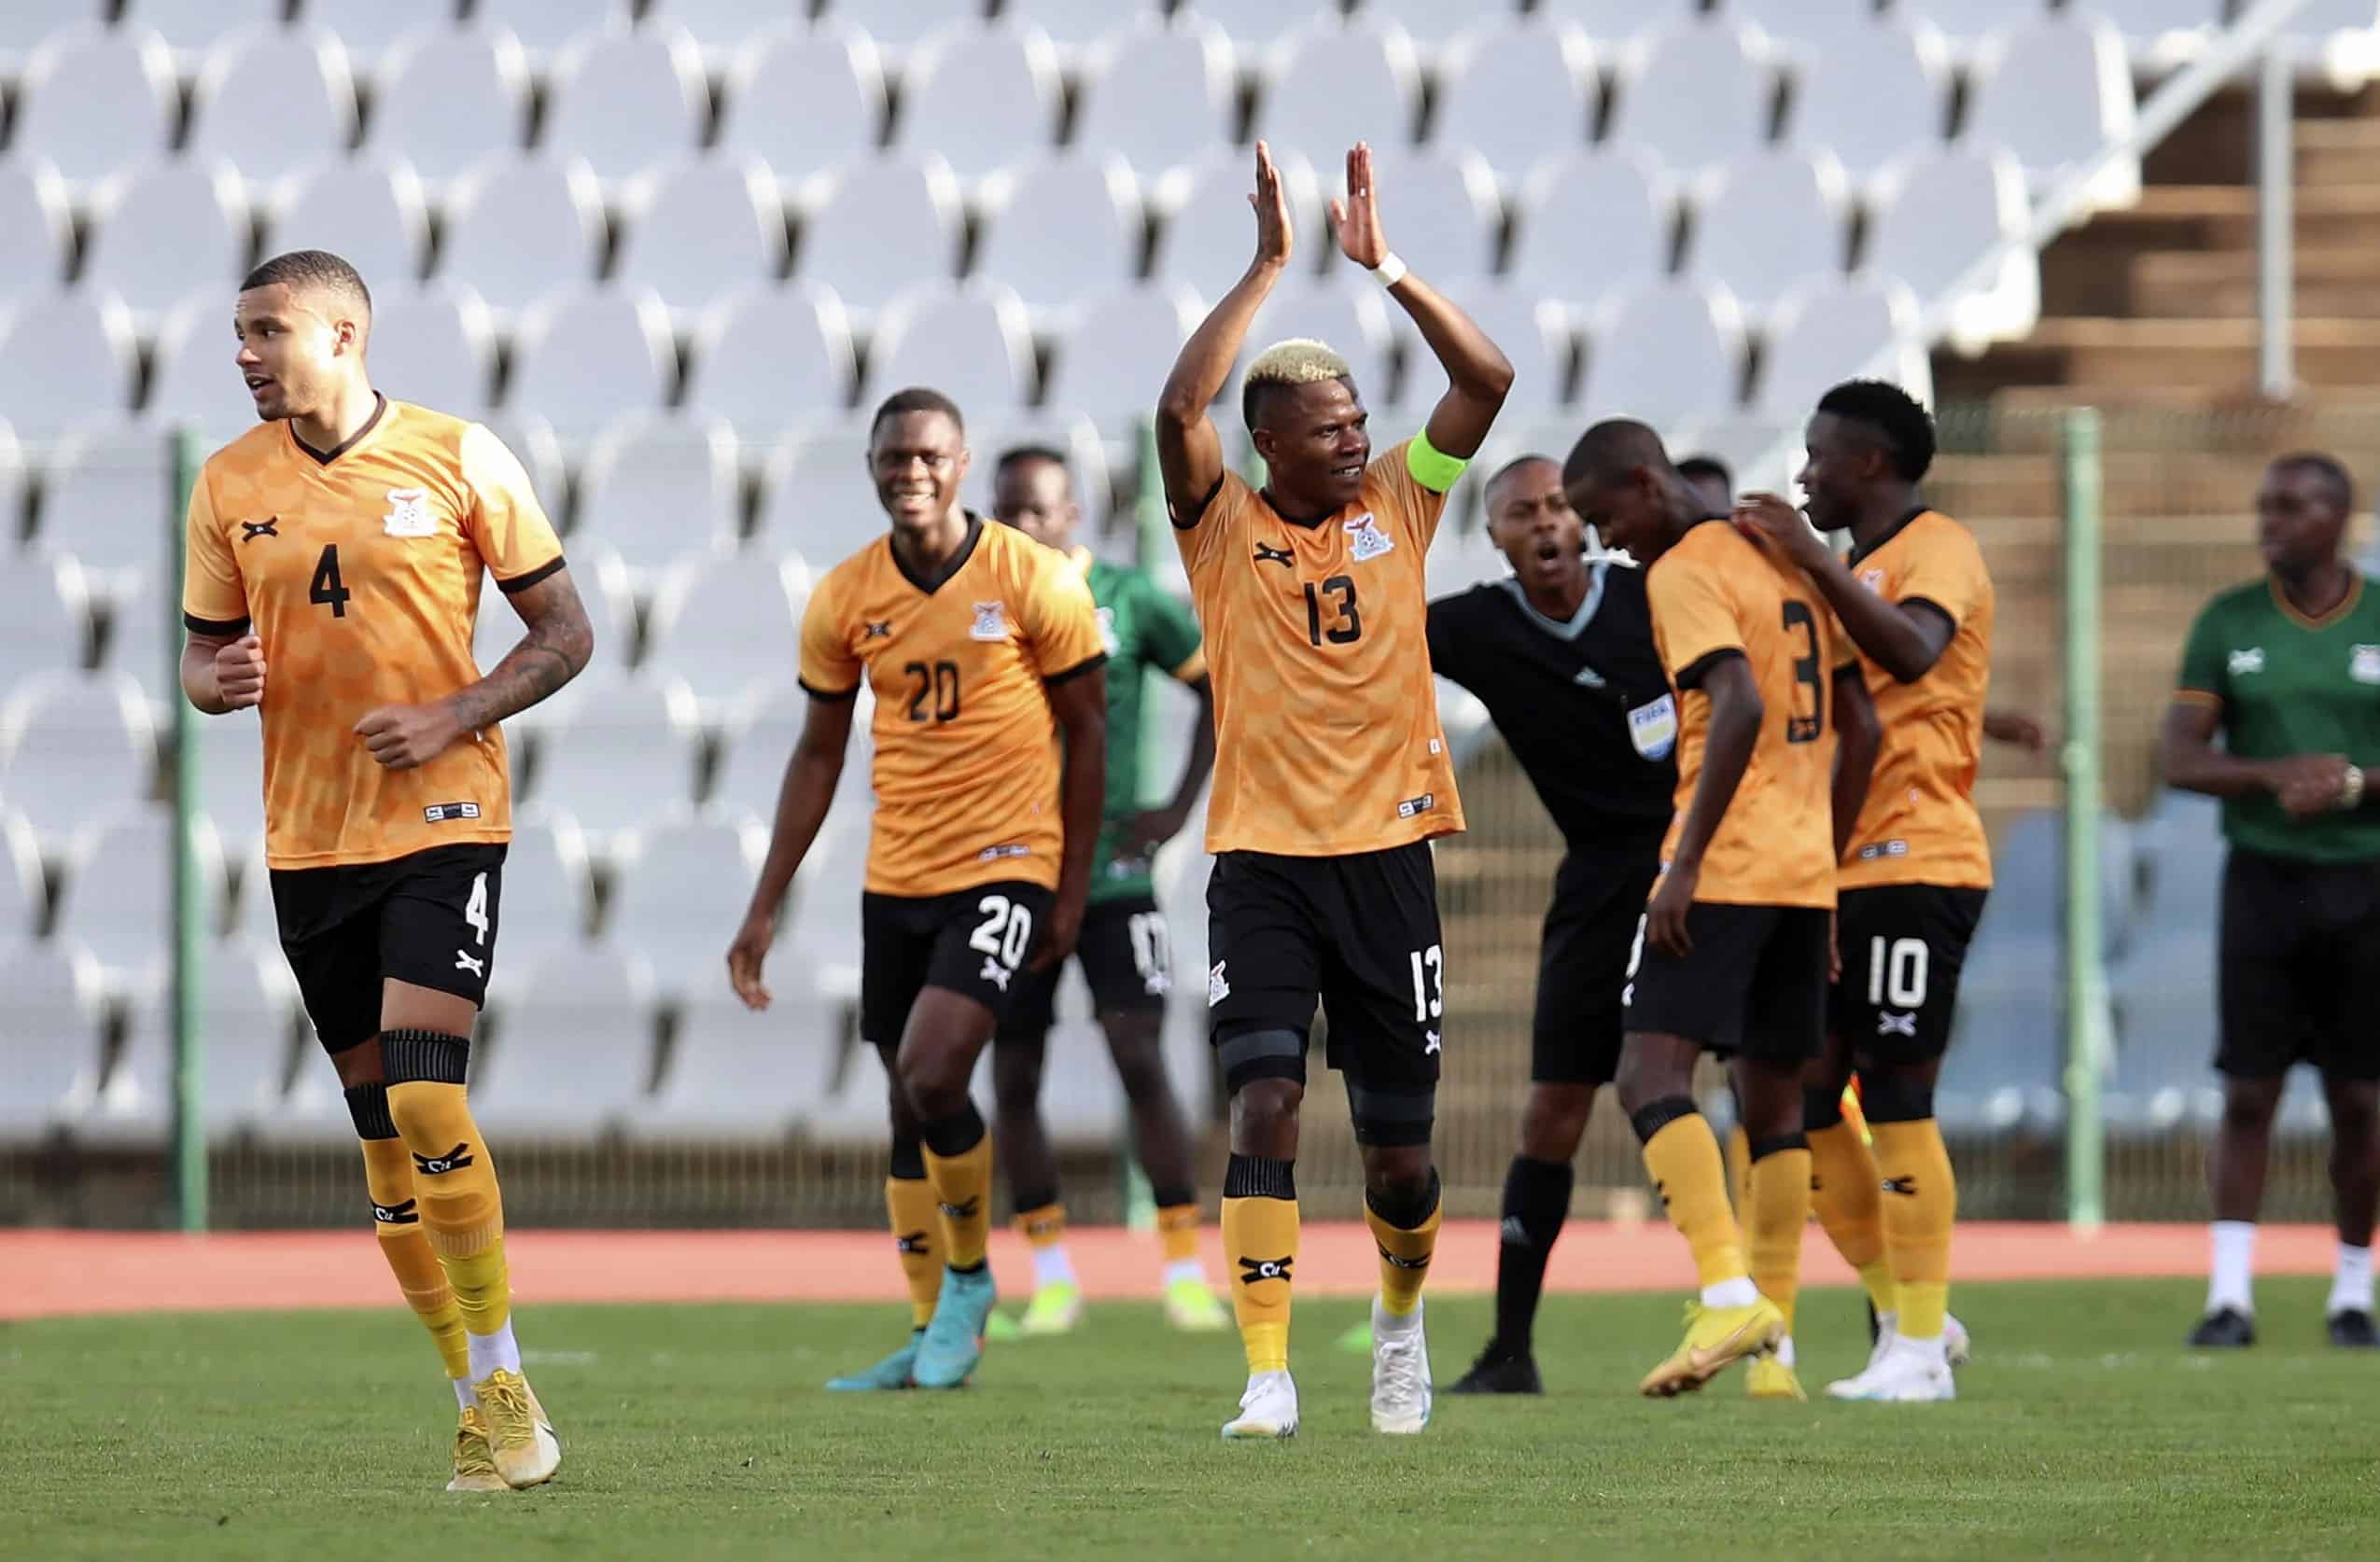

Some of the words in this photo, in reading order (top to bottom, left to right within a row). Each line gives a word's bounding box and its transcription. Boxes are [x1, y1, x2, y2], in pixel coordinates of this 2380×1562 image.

[309, 543, 351, 618] 4
[1304, 575, 1362, 646] 13
[904, 661, 959, 721] 20
[1782, 600, 1824, 743] 3
[466, 872, 489, 945] 4
[969, 895, 1032, 970] 20
[1410, 944, 1443, 1022] 13
[1868, 935, 1929, 1008] 10
